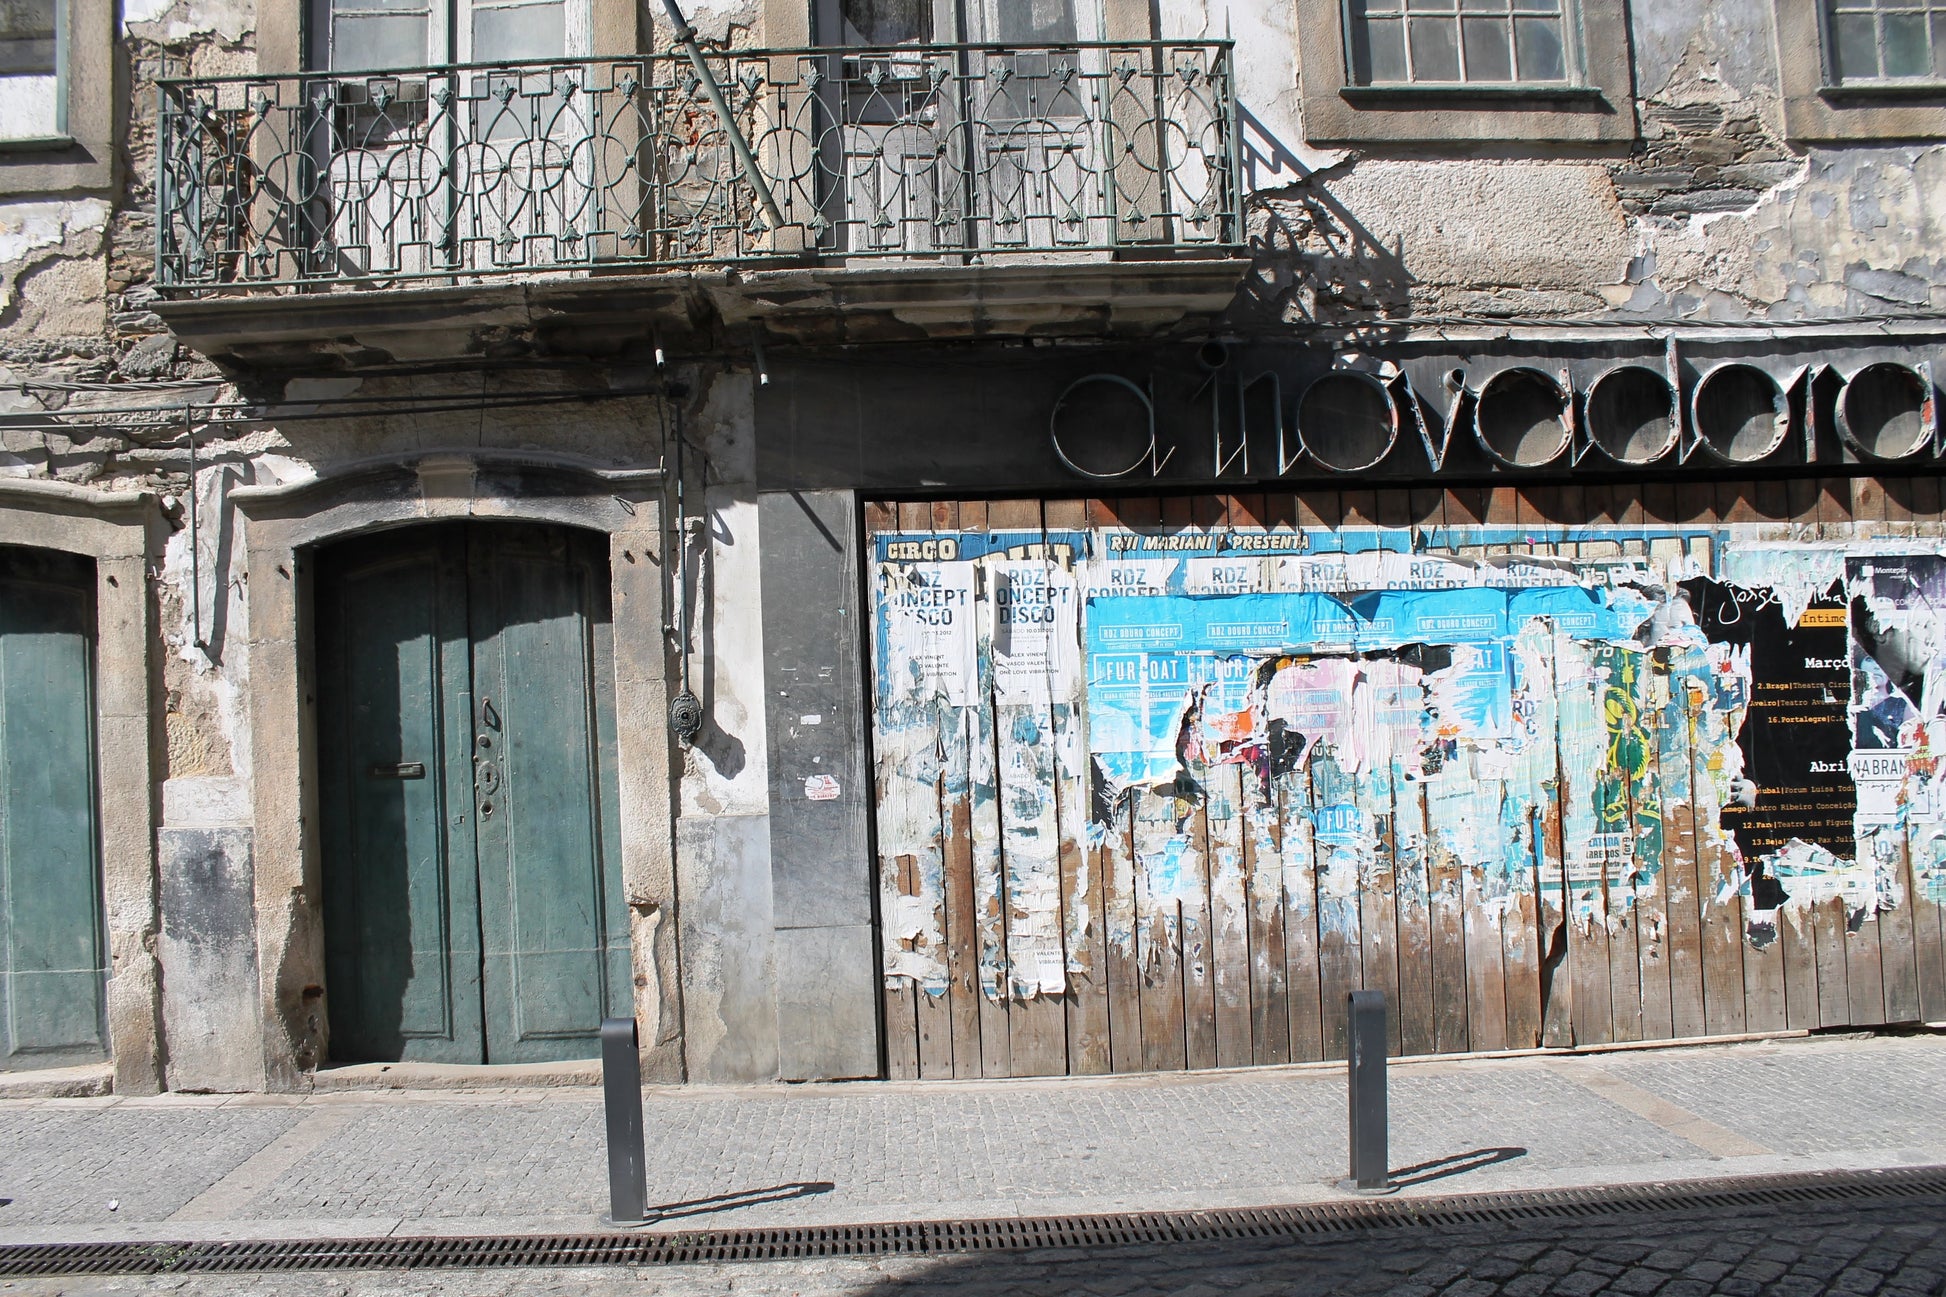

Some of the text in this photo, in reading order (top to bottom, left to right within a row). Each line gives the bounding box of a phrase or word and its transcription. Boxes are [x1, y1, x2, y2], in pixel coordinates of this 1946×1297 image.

[887, 538, 957, 561] CIRCO
[1110, 535, 1139, 551] RUI
[1142, 535, 1214, 551] MARIANI
[1008, 568, 1046, 586] RDZ
[1110, 568, 1147, 586] RDZ
[1212, 566, 1248, 584] RDZ
[1311, 563, 1346, 581] RDZ
[1410, 562, 1445, 579] RDZ
[996, 586, 1070, 606] ONCEPT
[999, 605, 1055, 625] DISCO
[1462, 617, 1493, 628] CONCEPT
[1120, 628, 1143, 638] DOURO
[1146, 626, 1178, 638] CONCEPT
[1228, 626, 1250, 635] DOURO
[1253, 625, 1284, 636] CONCEPT
[1105, 660, 1179, 682] FUR OAT
[1804, 657, 1849, 671] Março
[1809, 760, 1849, 774] Abri
